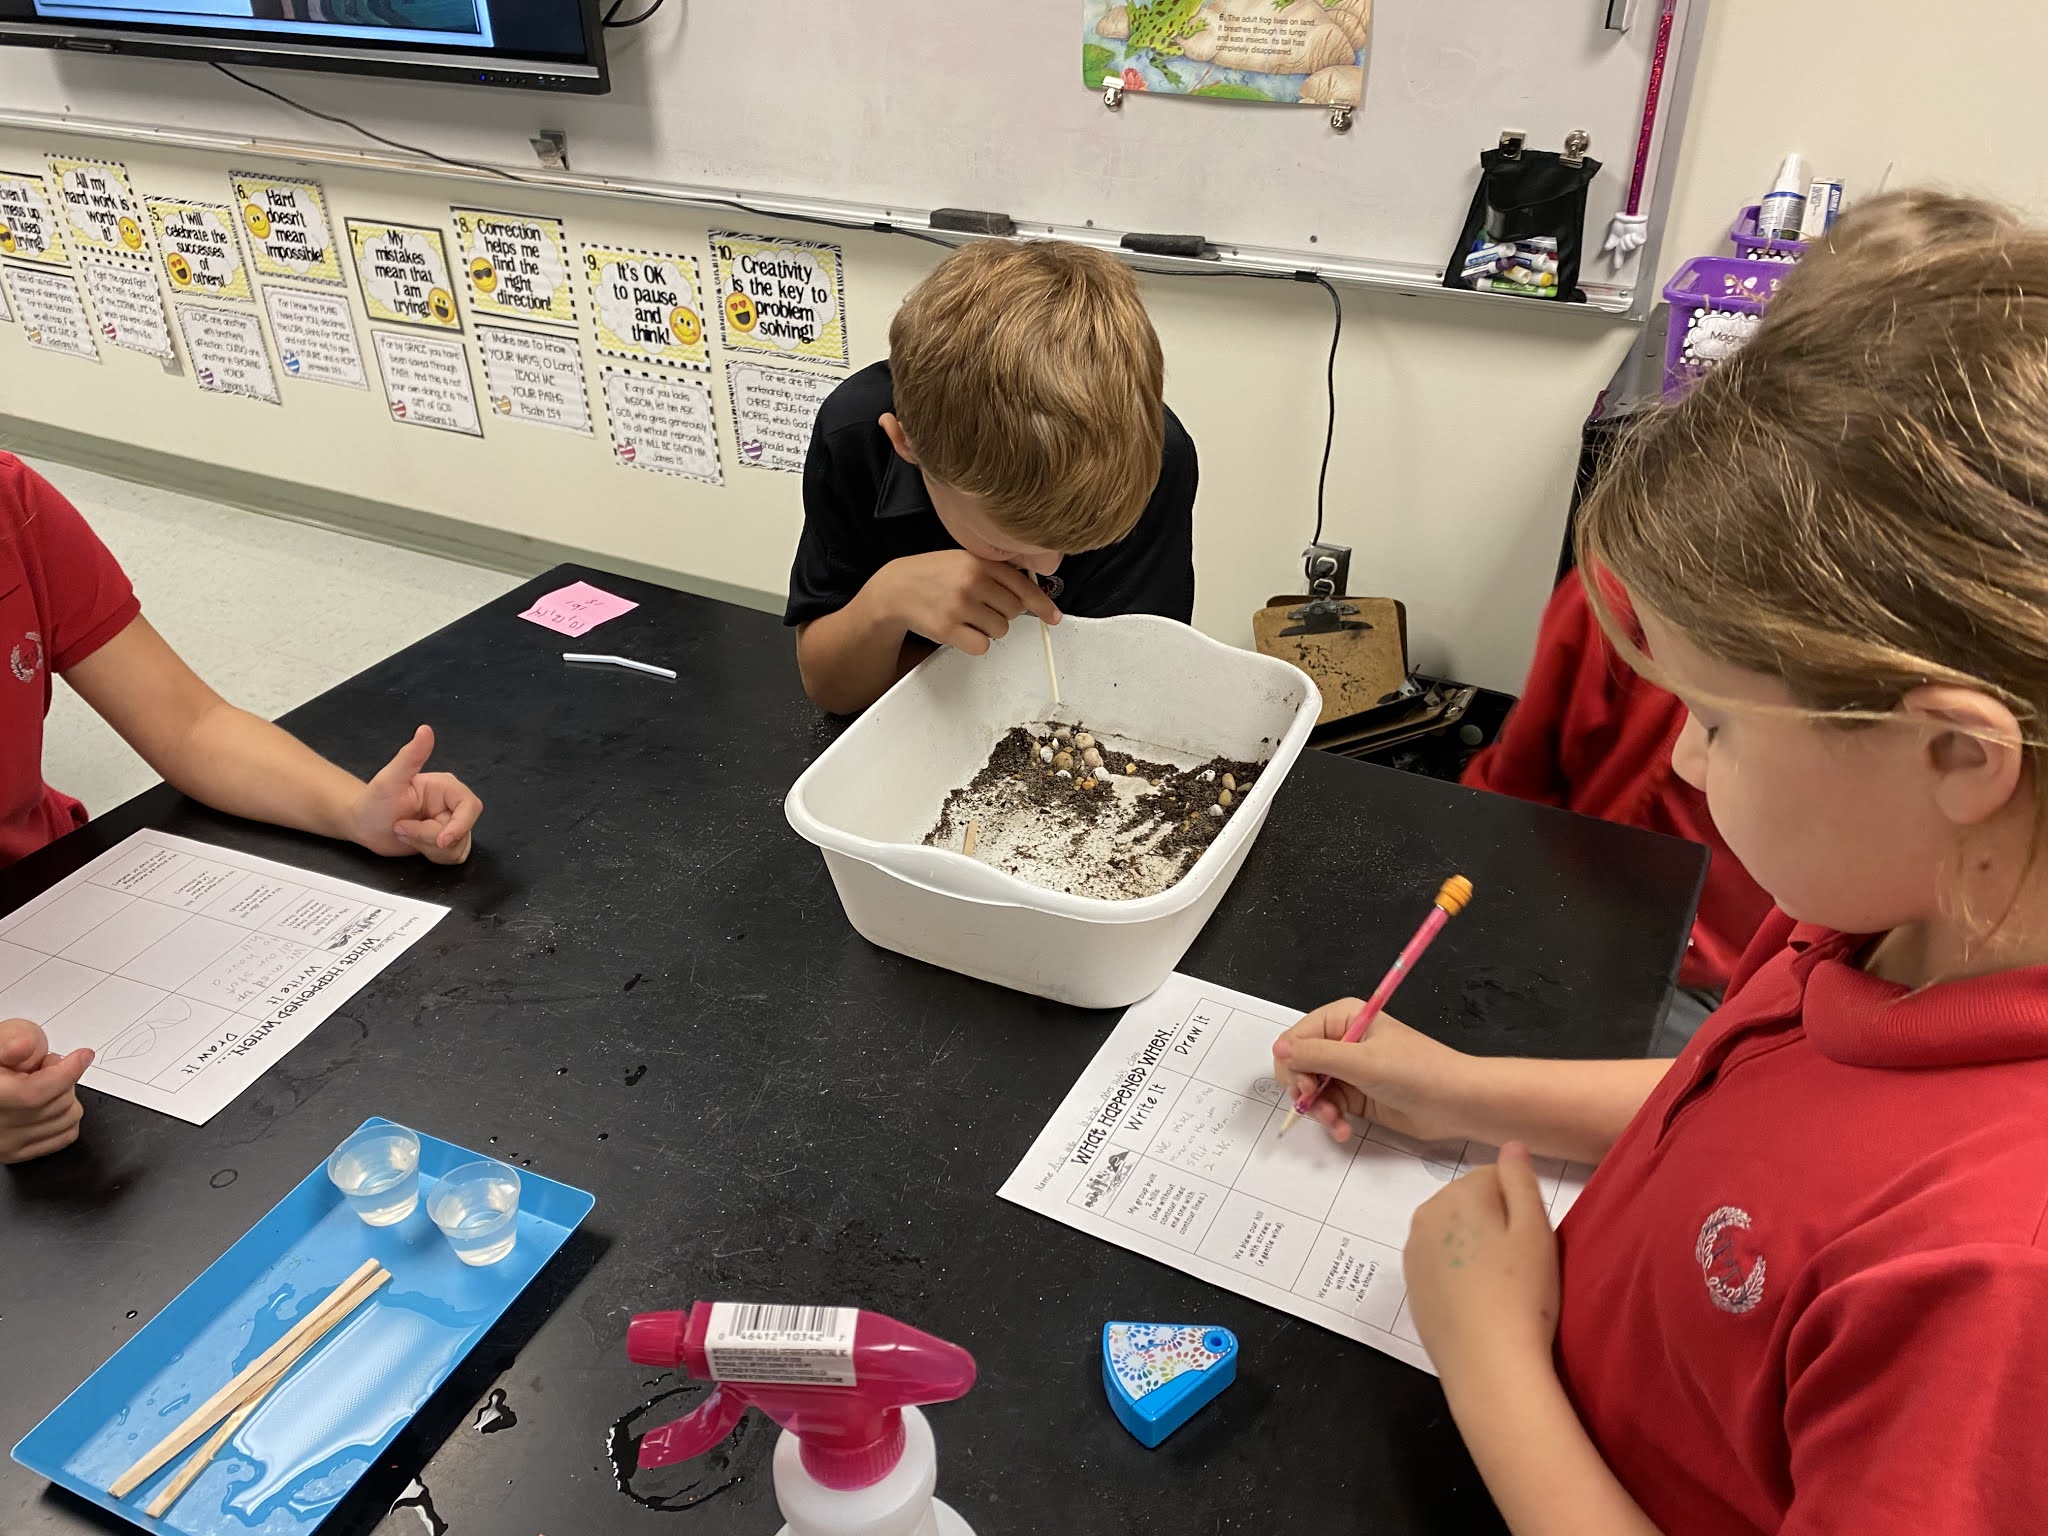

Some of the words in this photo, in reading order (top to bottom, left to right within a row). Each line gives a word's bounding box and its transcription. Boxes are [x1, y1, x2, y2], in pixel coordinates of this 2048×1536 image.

[1223, 25, 1252, 33] breathes
[1253, 27, 1278, 36] through
[1288, 28, 1307, 37] lungs
[1242, 16, 1258, 24] adult
[1259, 16, 1272, 25] frog
[1273, 17, 1288, 25] lives
[1300, 18, 1316, 27] land.
[1215, 44, 1249, 54] completely
[1251, 45, 1293, 56] disappeared.
[1281, 38, 1291, 46] tail
[75, 172, 88, 189] All
[90, 177, 106, 193] my
[237, 184, 248, 200] 6.
[20, 189, 29, 203] if
[63, 188, 89, 205] hard
[91, 194, 118, 209] work
[118, 195, 130, 211] is
[266, 189, 296, 208] Hard
[2, 204, 26, 217] mess
[86, 210, 117, 226] worth
[151, 207, 162, 221] 5.
[179, 211, 185, 223] I
[186, 212, 204, 226] will
[266, 208, 307, 228] doesn't
[20, 218, 41, 235] keep
[100, 226, 113, 242] it!
[459, 217, 472, 233] 8.
[477, 218, 542, 241] Correction
[15, 234, 44, 252] trying!
[165, 226, 209, 242] celebrate
[211, 228, 228, 244] the
[275, 229, 307, 244] mean
[350, 229, 363, 245] 7.
[387, 229, 403, 249] My
[176, 241, 224, 258] successes
[265, 241, 325, 264] impossible!
[375, 246, 426, 266] mistakes
[484, 236, 517, 257] helps
[521, 244, 540, 258] me
[717, 245, 735, 261] 10.
[199, 257, 210, 272] of
[492, 254, 516, 272] find
[520, 259, 540, 275] the
[587, 254, 600, 271] 9.
[741, 255, 812, 285] Creativity
[193, 272, 226, 288] others!
[375, 265, 406, 280] mean
[410, 266, 435, 284] that
[504, 274, 533, 292] right
[616, 262, 639, 282] It's
[644, 265, 666, 285] OK
[394, 281, 400, 296] I
[403, 285, 421, 298] am
[613, 283, 628, 300] to
[633, 287, 678, 306] pause
[731, 274, 744, 292] is
[750, 277, 772, 296] the
[778, 280, 804, 304] key
[811, 286, 827, 303] to
[393, 299, 431, 318] trying!
[497, 289, 552, 311] direction!
[635, 307, 662, 324] and
[755, 300, 814, 322] problem
[632, 323, 671, 345] think!
[760, 320, 815, 344] solving!
[492, 333, 515, 346] Make
[517, 338, 530, 349] me
[532, 339, 543, 350] to
[544, 341, 566, 354] know
[489, 349, 514, 361] YOUR
[515, 353, 542, 369] WAYS,
[552, 359, 576, 376] Lord,
[514, 369, 540, 383] TEACH
[541, 373, 556, 386] ME
[511, 385, 536, 398] YOUR
[520, 403, 545, 417] Psalm
[773, 402, 797, 413] JESUS
[793, 419, 808, 429] God
[280, 965, 322, 994] Write
[266, 995, 284, 1005] It
[1175, 1027, 1202, 1055] Draw
[1193, 1015, 1210, 1026] It
[198, 1032, 238, 1062] Draw
[181, 1064, 200, 1075] It
[1124, 1096, 1157, 1131] Write
[1148, 1083, 1167, 1095] It
[1155, 1140, 1171, 1154] We
[1034, 1171, 1053, 1191] Name
[1127, 1205, 1139, 1215] My
[1137, 1187, 1149, 1207] group
[1147, 1173, 1157, 1187] built
[1149, 1206, 1161, 1221] (one
[1160, 1183, 1175, 1206] without
[1150, 1189, 1160, 1201] hills
[1160, 1203, 1175, 1225] contour
[1173, 1187, 1186, 1203] lines
[1170, 1215, 1180, 1229] and
[1178, 1204, 1187, 1216] one
[1186, 1191, 1195, 1205] with
[1180, 1211, 1195, 1235] contour
[1194, 1192, 1208, 1211] lines)
[1233, 1249, 1243, 1260] We
[1242, 1234, 1251, 1250] blew
[1249, 1222, 1258, 1233] our
[1254, 1211, 1264, 1221] hill
[1248, 1242, 1258, 1257] with
[1257, 1222, 1271, 1244] straws
[1255, 1259, 1264, 1267] (a
[1263, 1240, 1275, 1260] gentle
[1316, 1287, 1327, 1298] We
[1325, 1260, 1339, 1287] sprayed
[1337, 1249, 1345, 1260] our
[1341, 1237, 1351, 1247] hill
[1336, 1275, 1346, 1289] with
[1343, 1256, 1354, 1275] water
[1352, 1263, 1364, 1284] gentle
[1356, 1289, 1366, 1302] rain
[718, 1333, 725, 1341] 0
[740, 1332, 777, 1341] 46412
[786, 1333, 823, 1342] 10342
